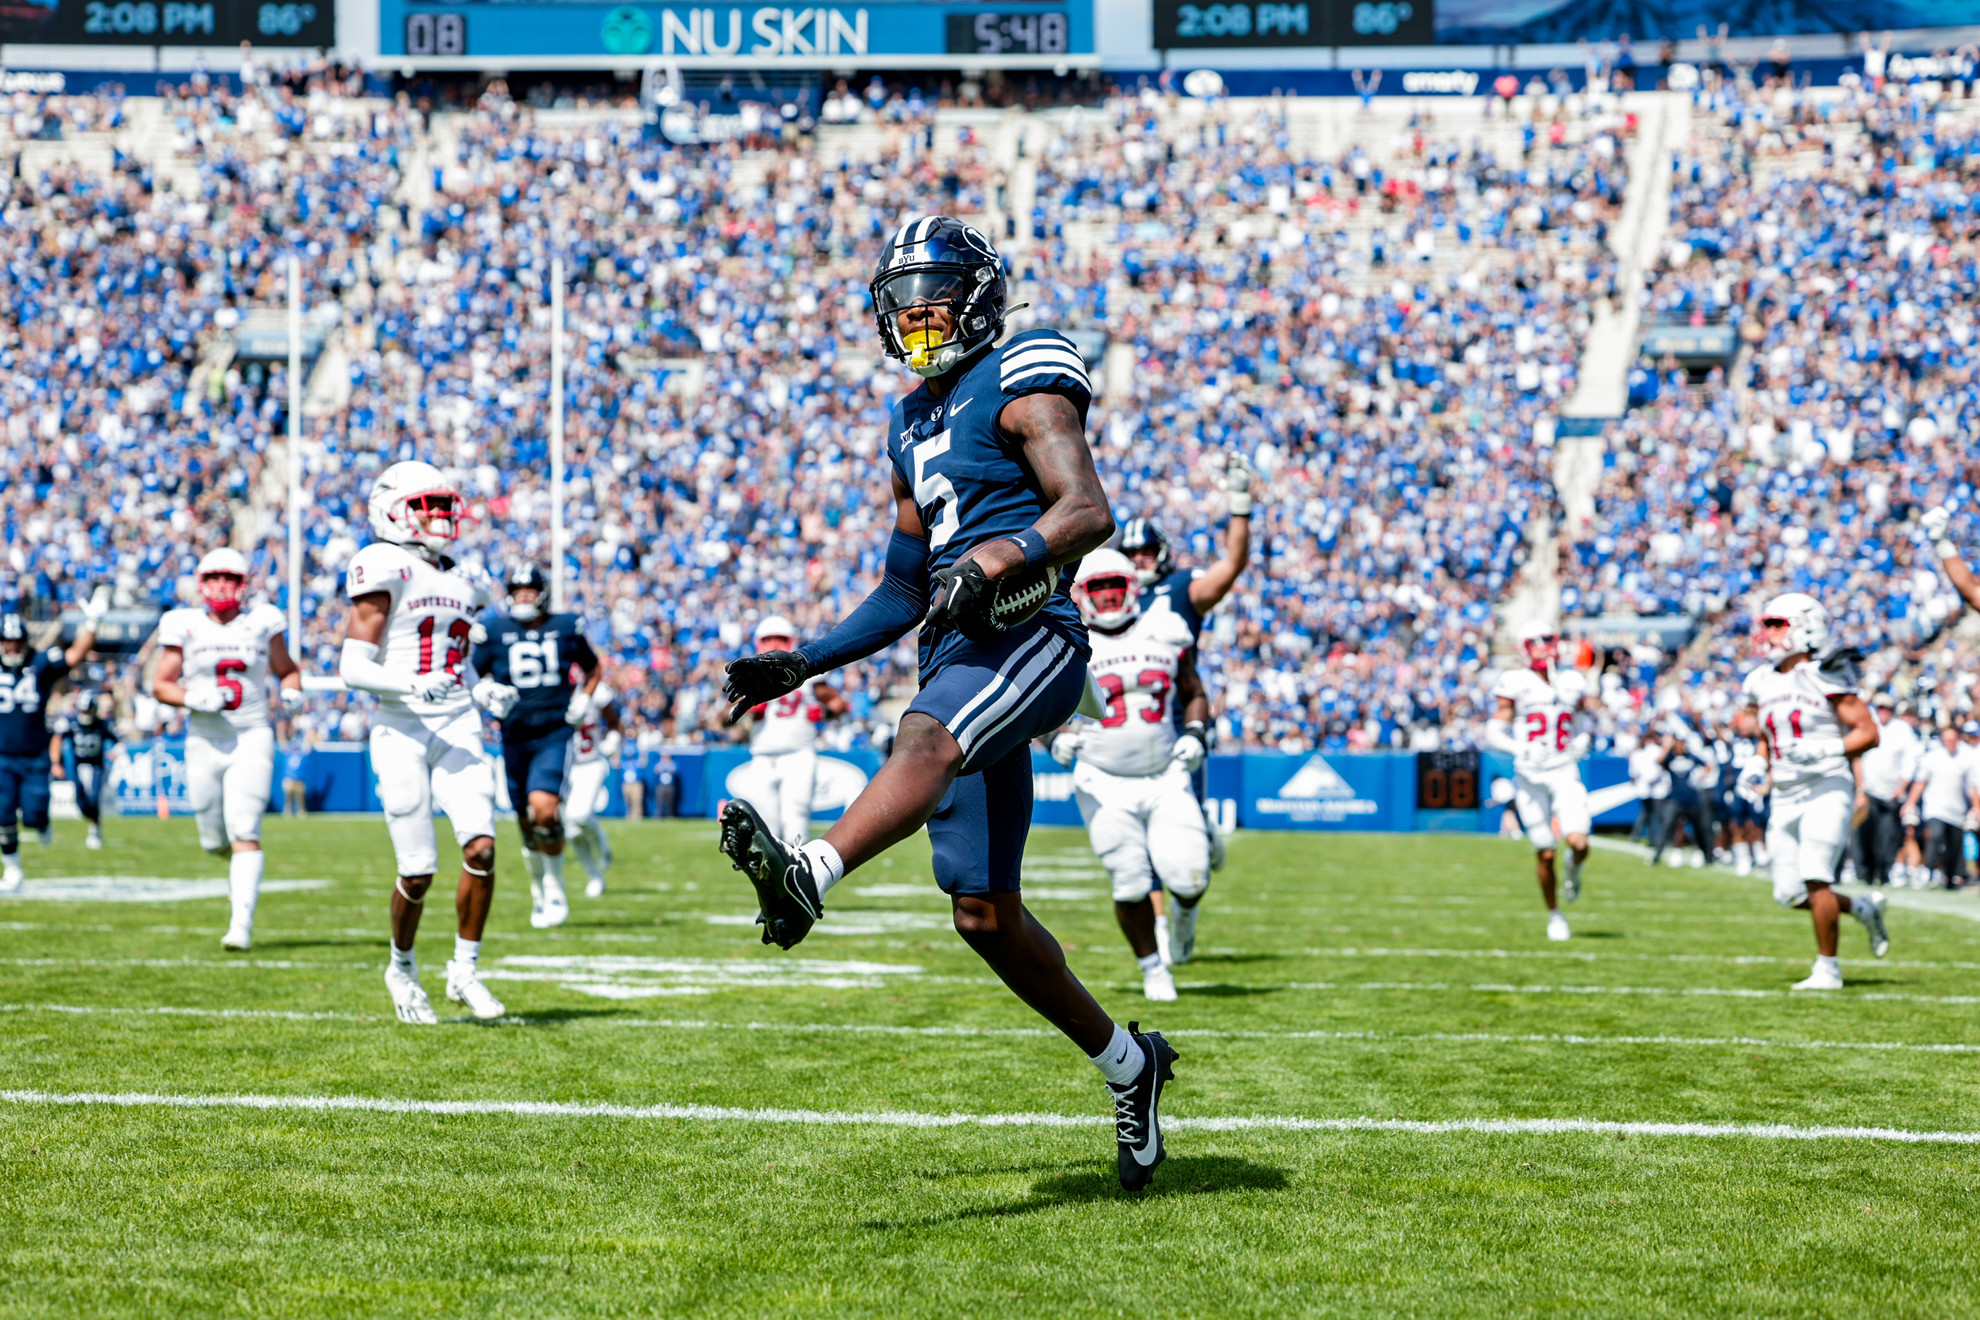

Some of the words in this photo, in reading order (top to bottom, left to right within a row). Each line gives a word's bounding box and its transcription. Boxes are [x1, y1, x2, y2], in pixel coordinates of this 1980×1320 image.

[163, 3, 214, 35] PM
[407, 14, 464, 55] 08
[662, 8, 741, 55] NU
[752, 7, 868, 55] SKIN
[974, 13, 1067, 54] 5:48
[1177, 3, 1251, 36] 2:08
[1256, 3, 1308, 35] PM
[898, 254, 915, 265] BYU
[913, 428, 960, 551] 5
[418, 616, 472, 686] 12
[508, 640, 561, 688] 61
[1526, 712, 1573, 751] 26
[1765, 709, 1803, 760] 11
[1423, 769, 1475, 808] 08
